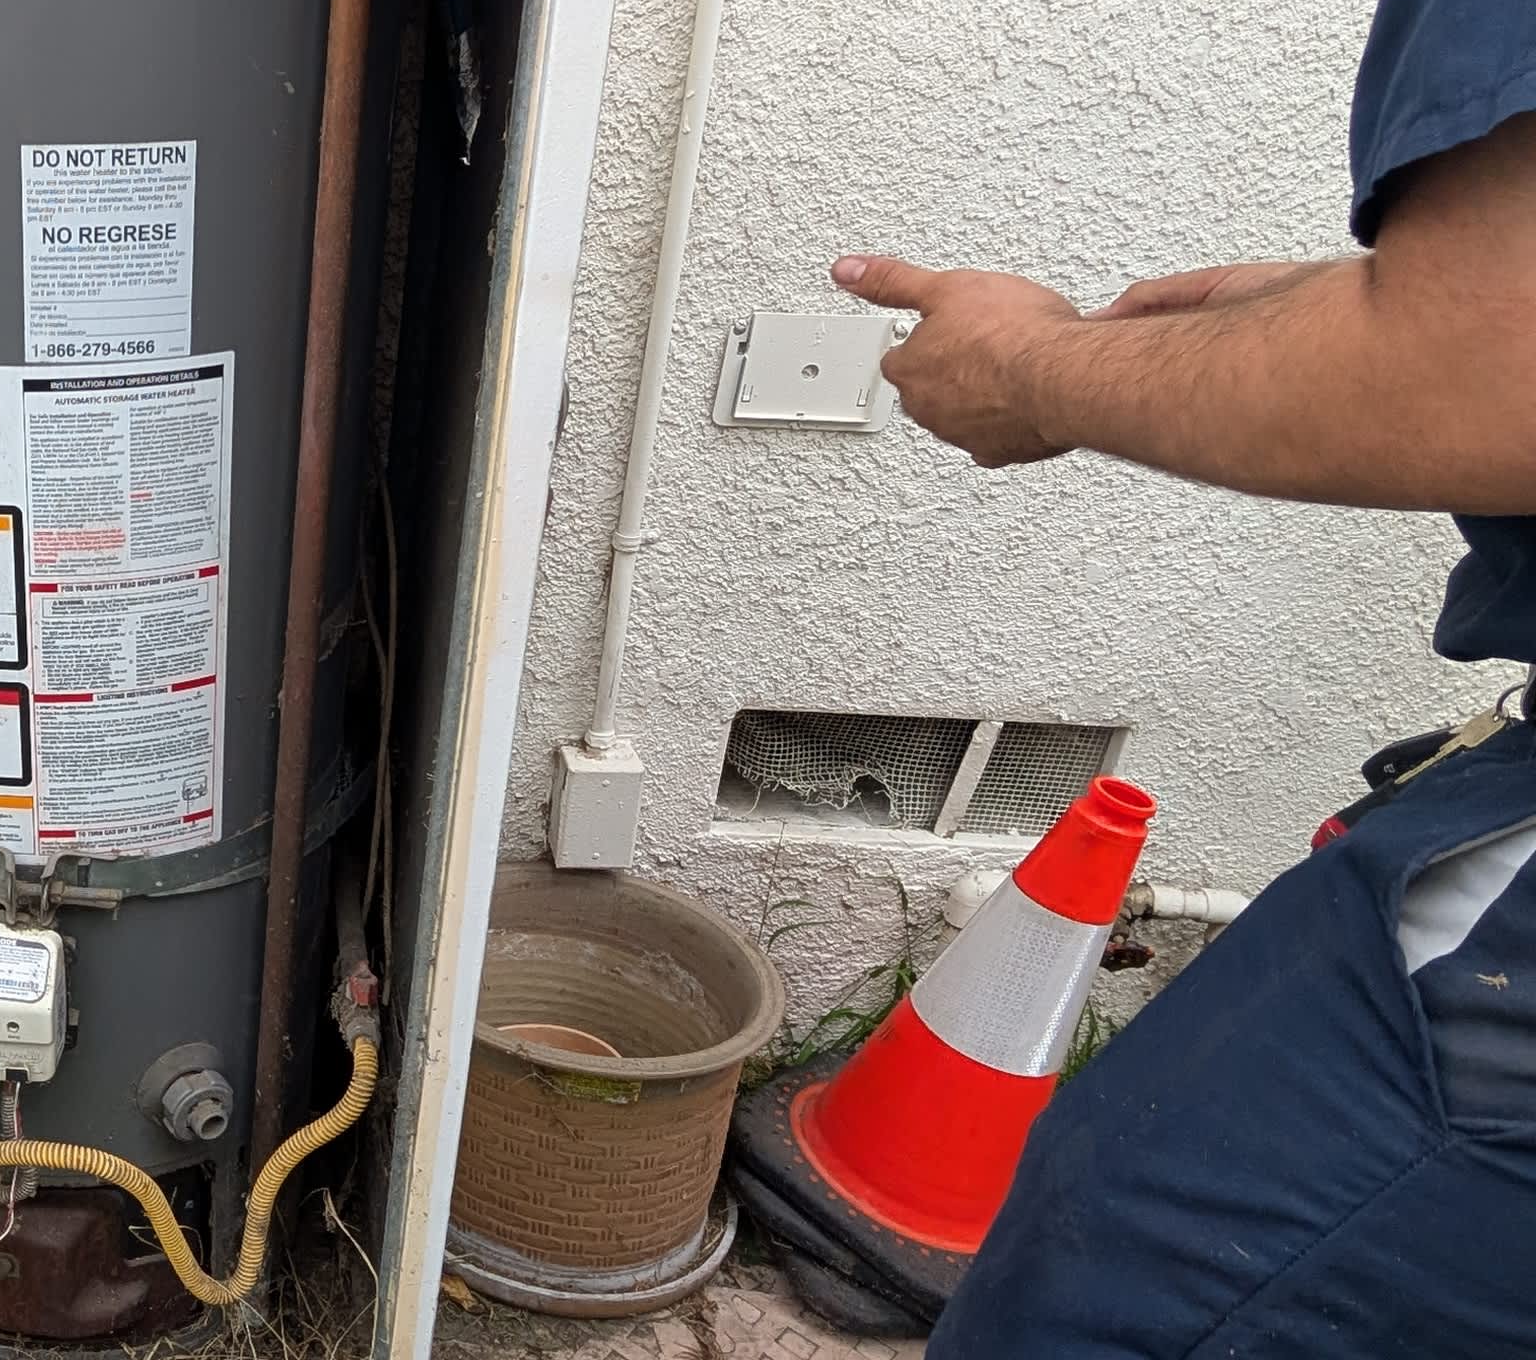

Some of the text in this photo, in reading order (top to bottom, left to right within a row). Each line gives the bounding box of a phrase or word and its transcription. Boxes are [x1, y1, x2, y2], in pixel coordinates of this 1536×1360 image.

[33, 146, 186, 167] DO NOT RETURN
[129, 167, 142, 175] the
[42, 223, 176, 244] NO REGRESE
[111, 245, 130, 253] agua
[31, 340, 155, 357] 1-866-279-4566
[50, 381, 105, 390] INSTALLATION
[107, 379, 124, 387] AND
[55, 397, 101, 405] AUTOMATIC
[104, 394, 139, 403] STORAGE
[168, 388, 196, 397] HEATER
[94, 583, 117, 591] SAFETY
